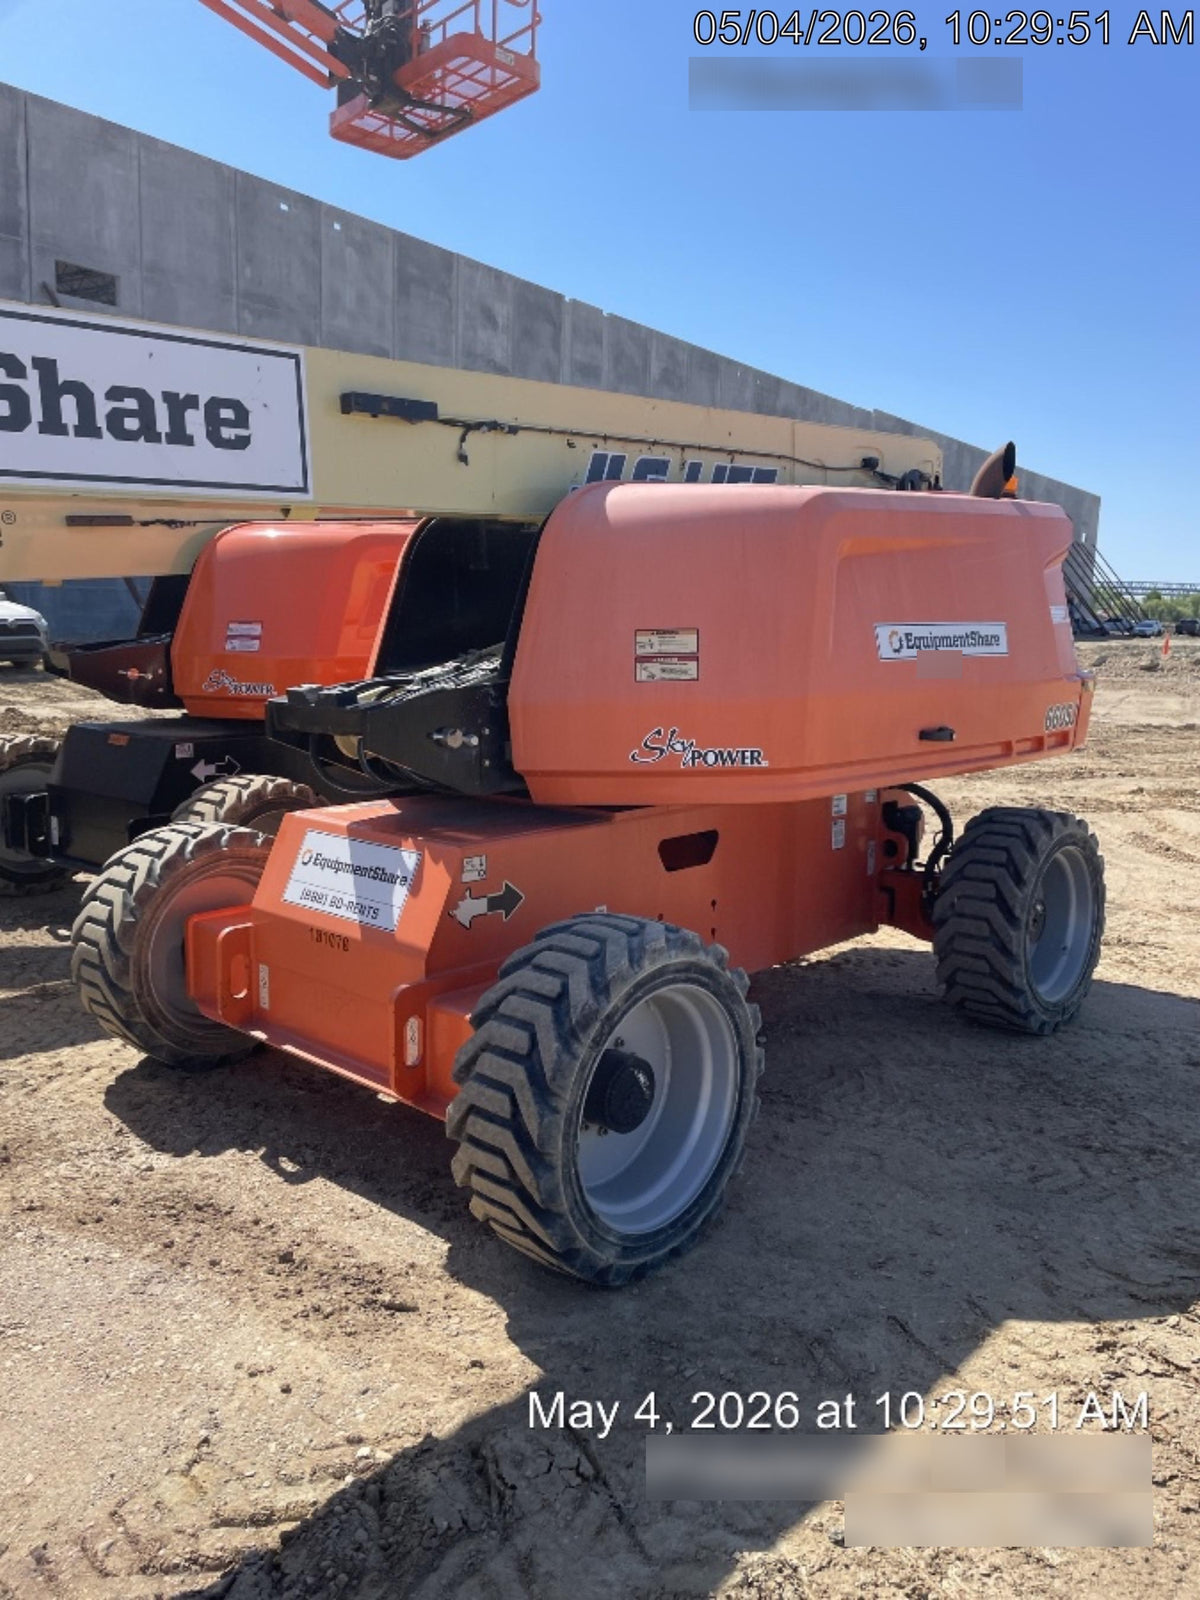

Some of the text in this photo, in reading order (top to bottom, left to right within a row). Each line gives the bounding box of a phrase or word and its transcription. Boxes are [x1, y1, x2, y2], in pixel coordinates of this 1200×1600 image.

[904, 630, 1001, 651] EquipmentShare
[689, 748, 763, 768] POWER
[312, 852, 408, 887] EquipmentShare
